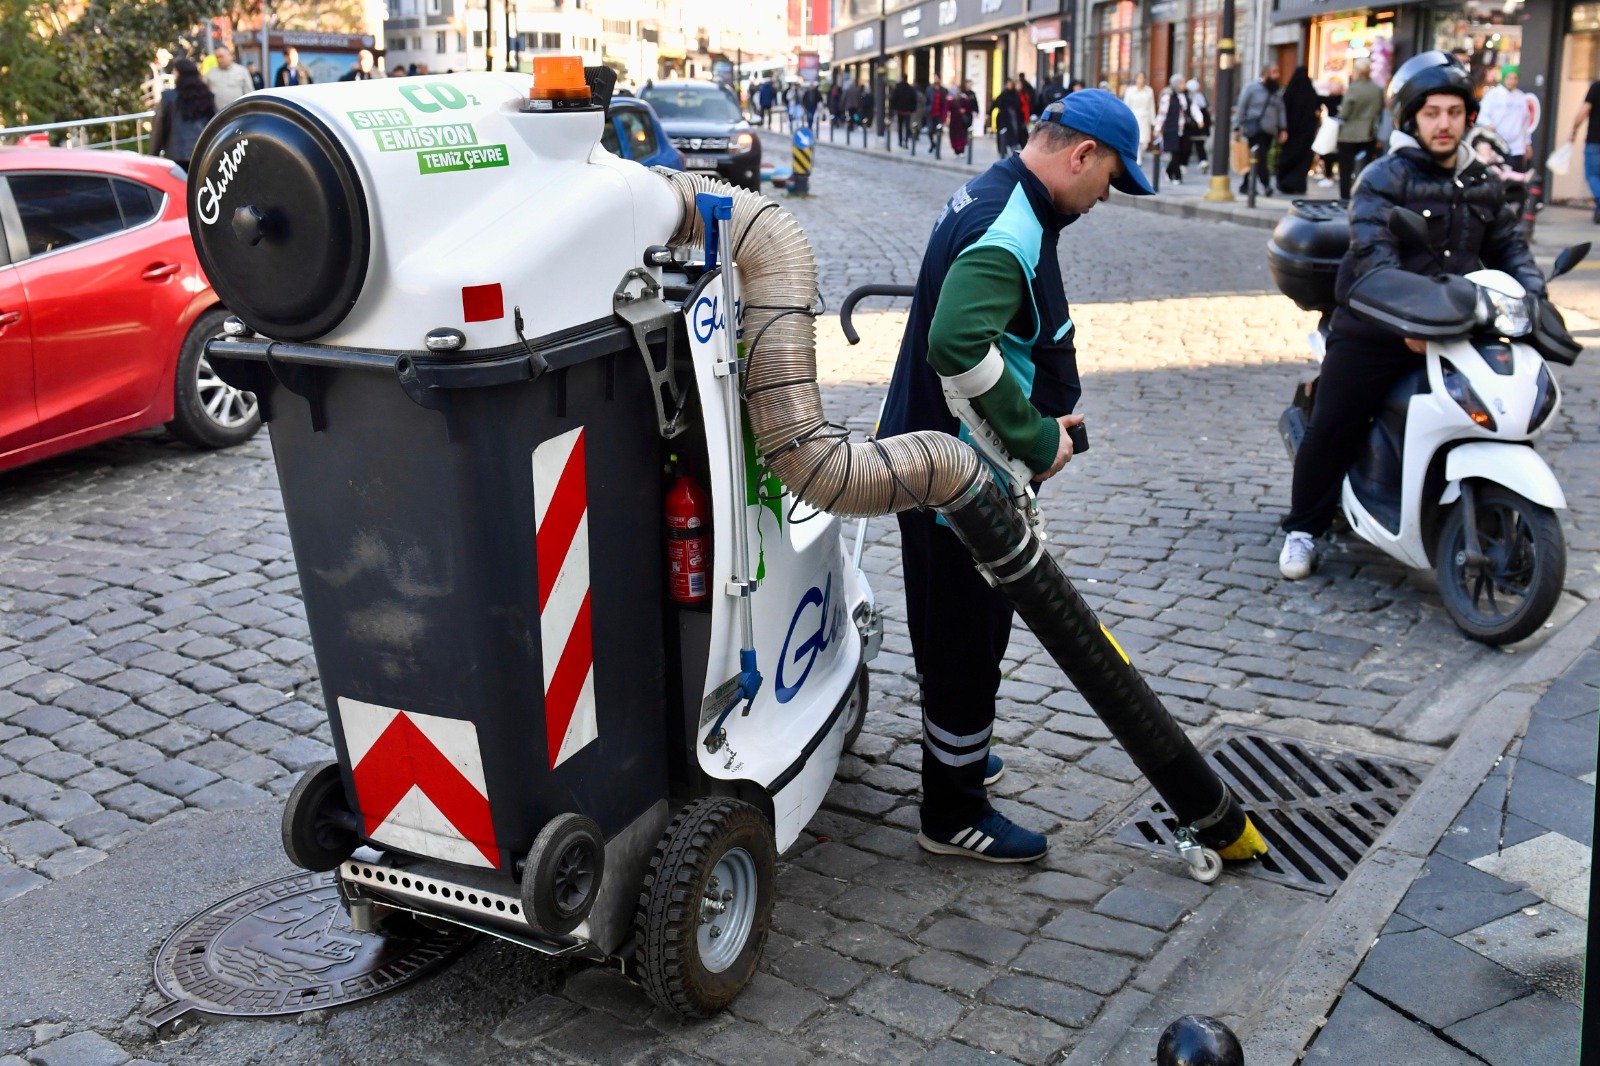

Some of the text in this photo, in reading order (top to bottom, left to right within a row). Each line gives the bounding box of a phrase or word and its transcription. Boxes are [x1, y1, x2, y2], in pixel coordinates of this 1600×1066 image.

[353, 109, 408, 128] SIFIR
[463, 148, 504, 169] ÇEVRE
[197, 138, 249, 225] Glutton
